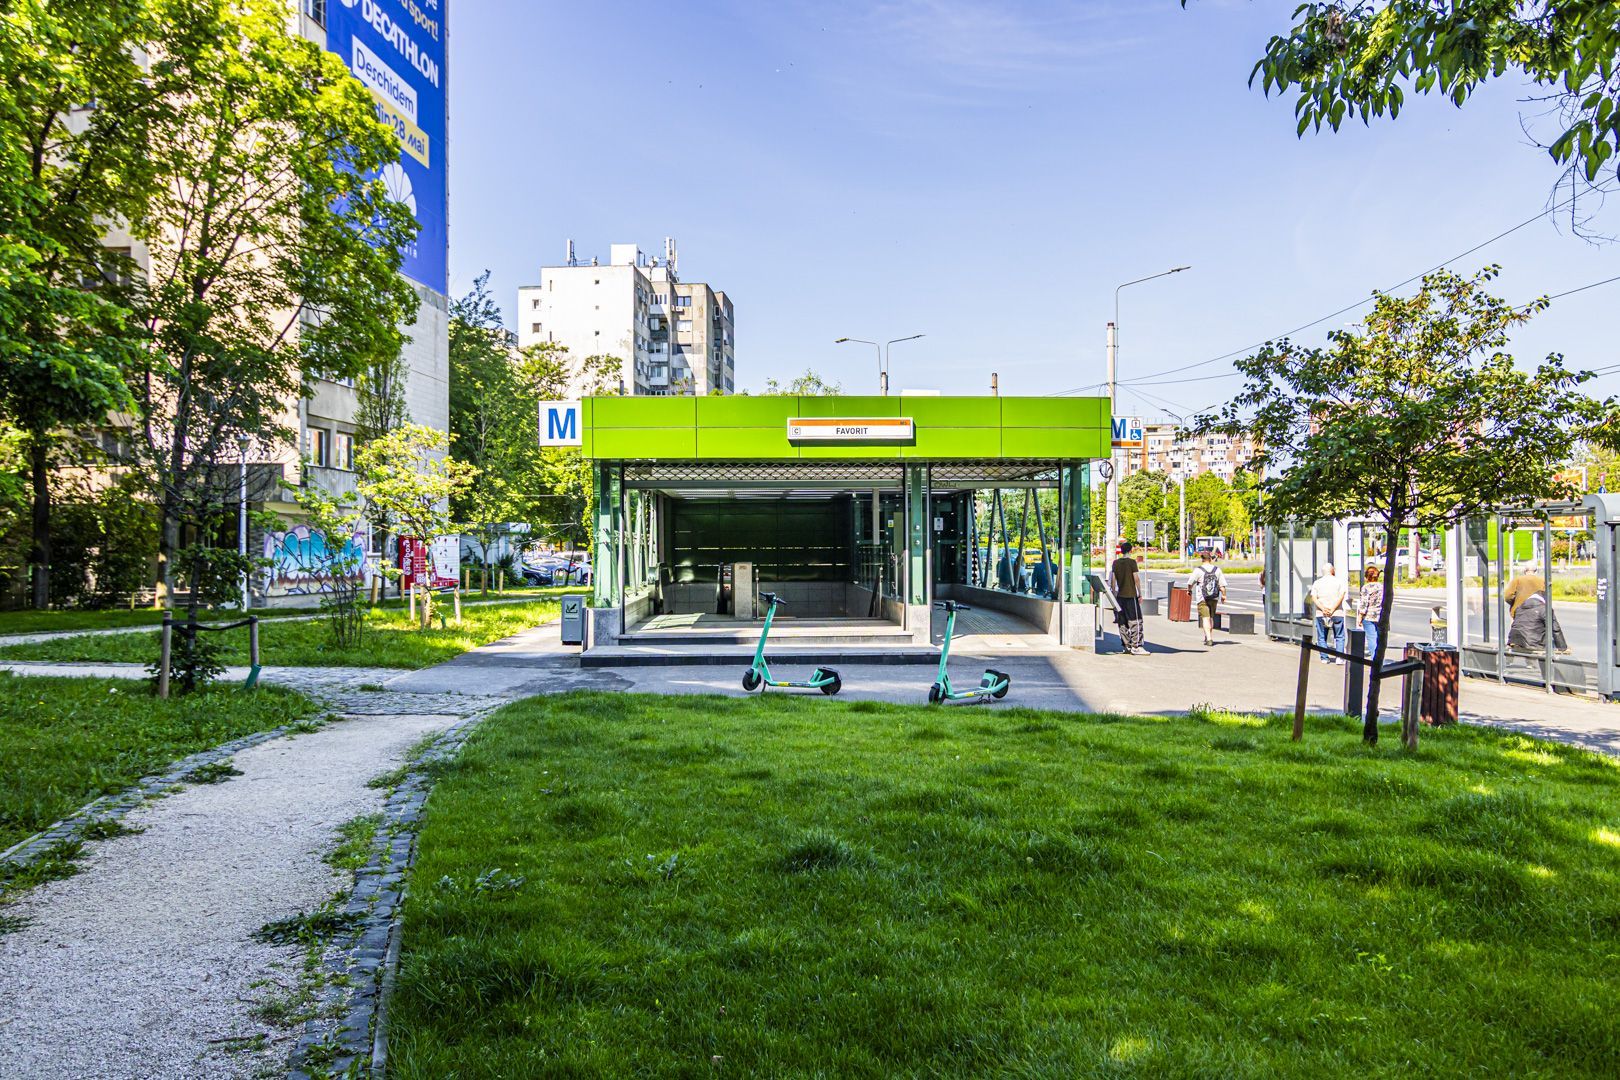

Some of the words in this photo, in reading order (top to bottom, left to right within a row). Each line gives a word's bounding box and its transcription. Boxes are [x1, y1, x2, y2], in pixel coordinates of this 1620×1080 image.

[361, 0, 439, 88] DECATHLON
[356, 47, 414, 115] Deschidem
[392, 114, 406, 140] 28
[407, 133, 425, 156] mai
[548, 408, 576, 439] M
[836, 427, 868, 435] FAVORIT
[1111, 418, 1126, 438] M
